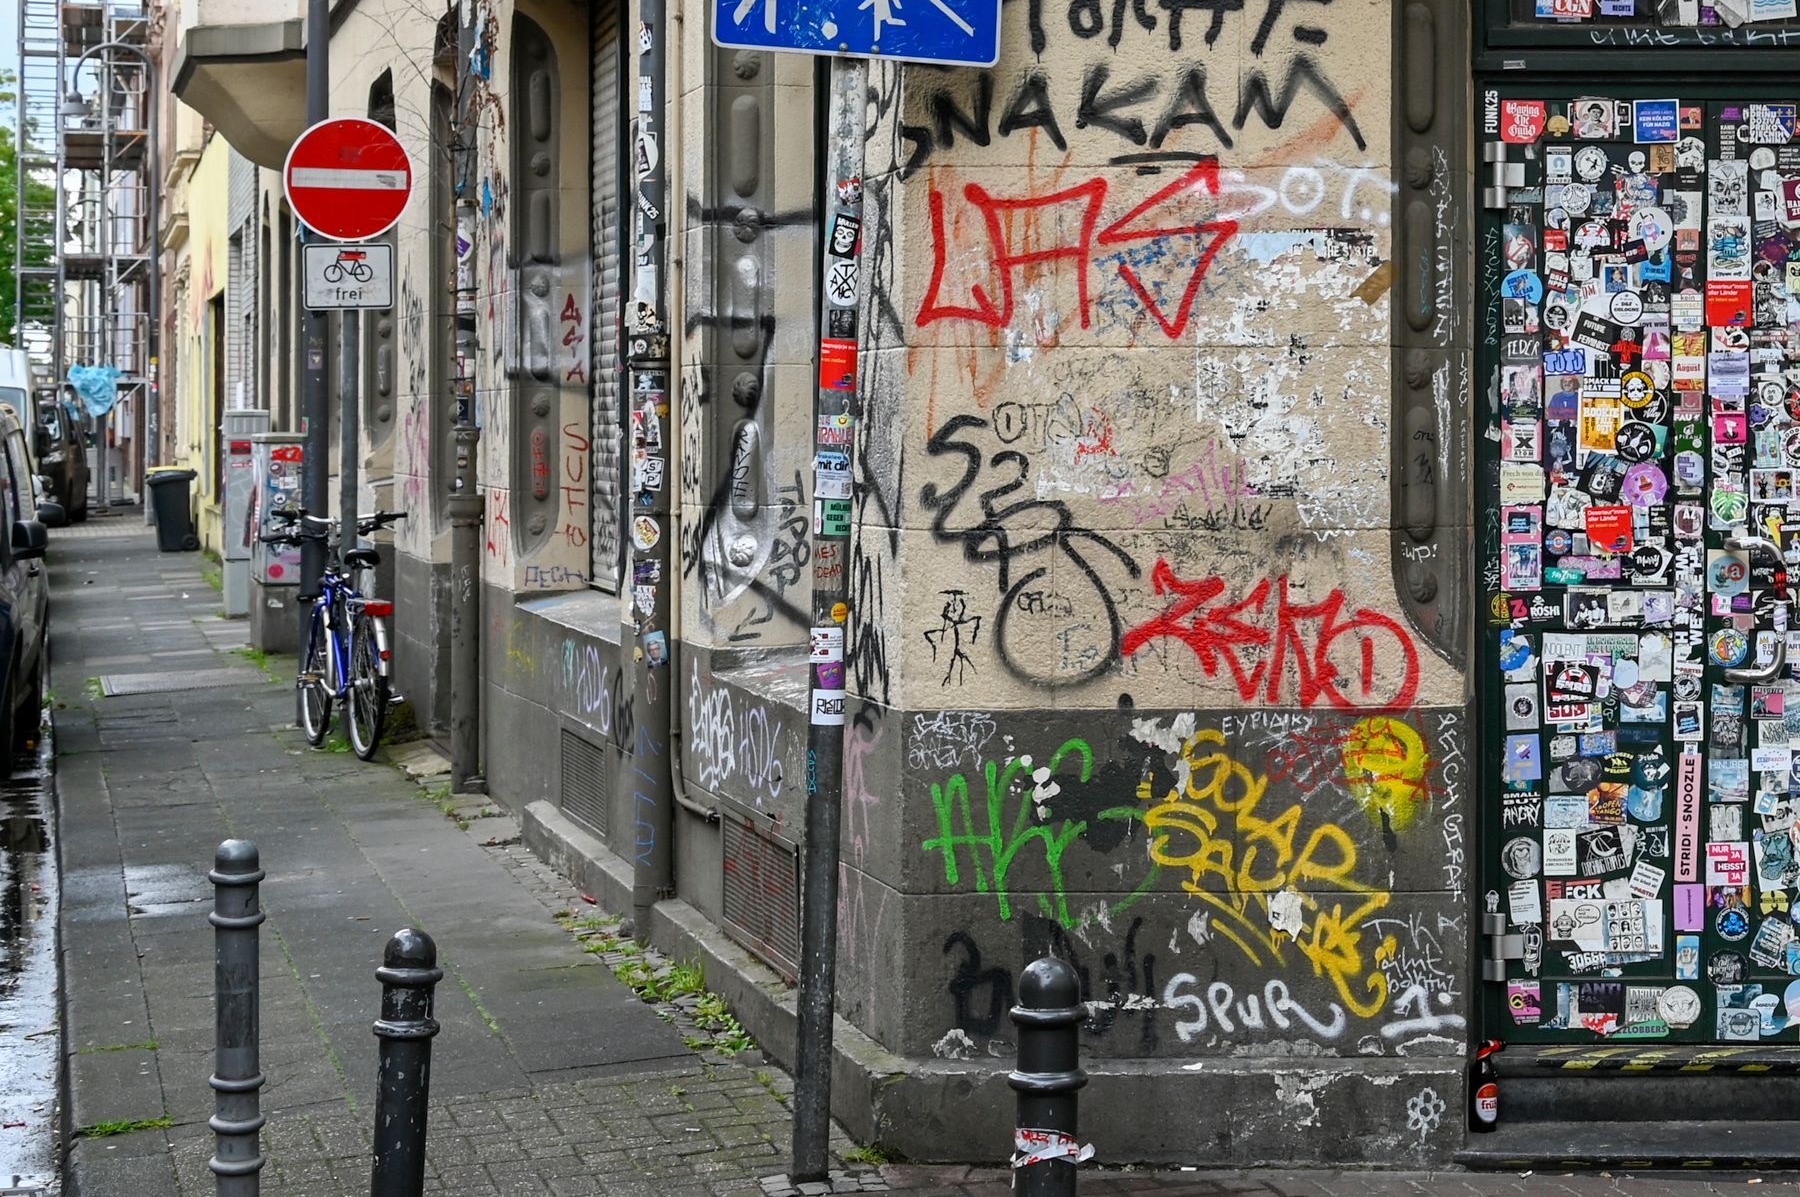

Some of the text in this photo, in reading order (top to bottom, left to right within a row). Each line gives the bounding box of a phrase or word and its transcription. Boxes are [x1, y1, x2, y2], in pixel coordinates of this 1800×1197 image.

[1485, 90, 1498, 134] FUNK25
[335, 287, 363, 300] frei
[1683, 316, 1699, 324] egal
[1676, 363, 1700, 373] August
[1502, 469, 1522, 478] Frech
[1502, 790, 1541, 799] SMALL
[1503, 804, 1541, 830] ANGRY
[1681, 758, 1695, 876] STRIDI SNOOZLE
[1731, 851, 1741, 859] JA
[1731, 873, 1741, 881] JA
[1565, 885, 1602, 898] FCK
